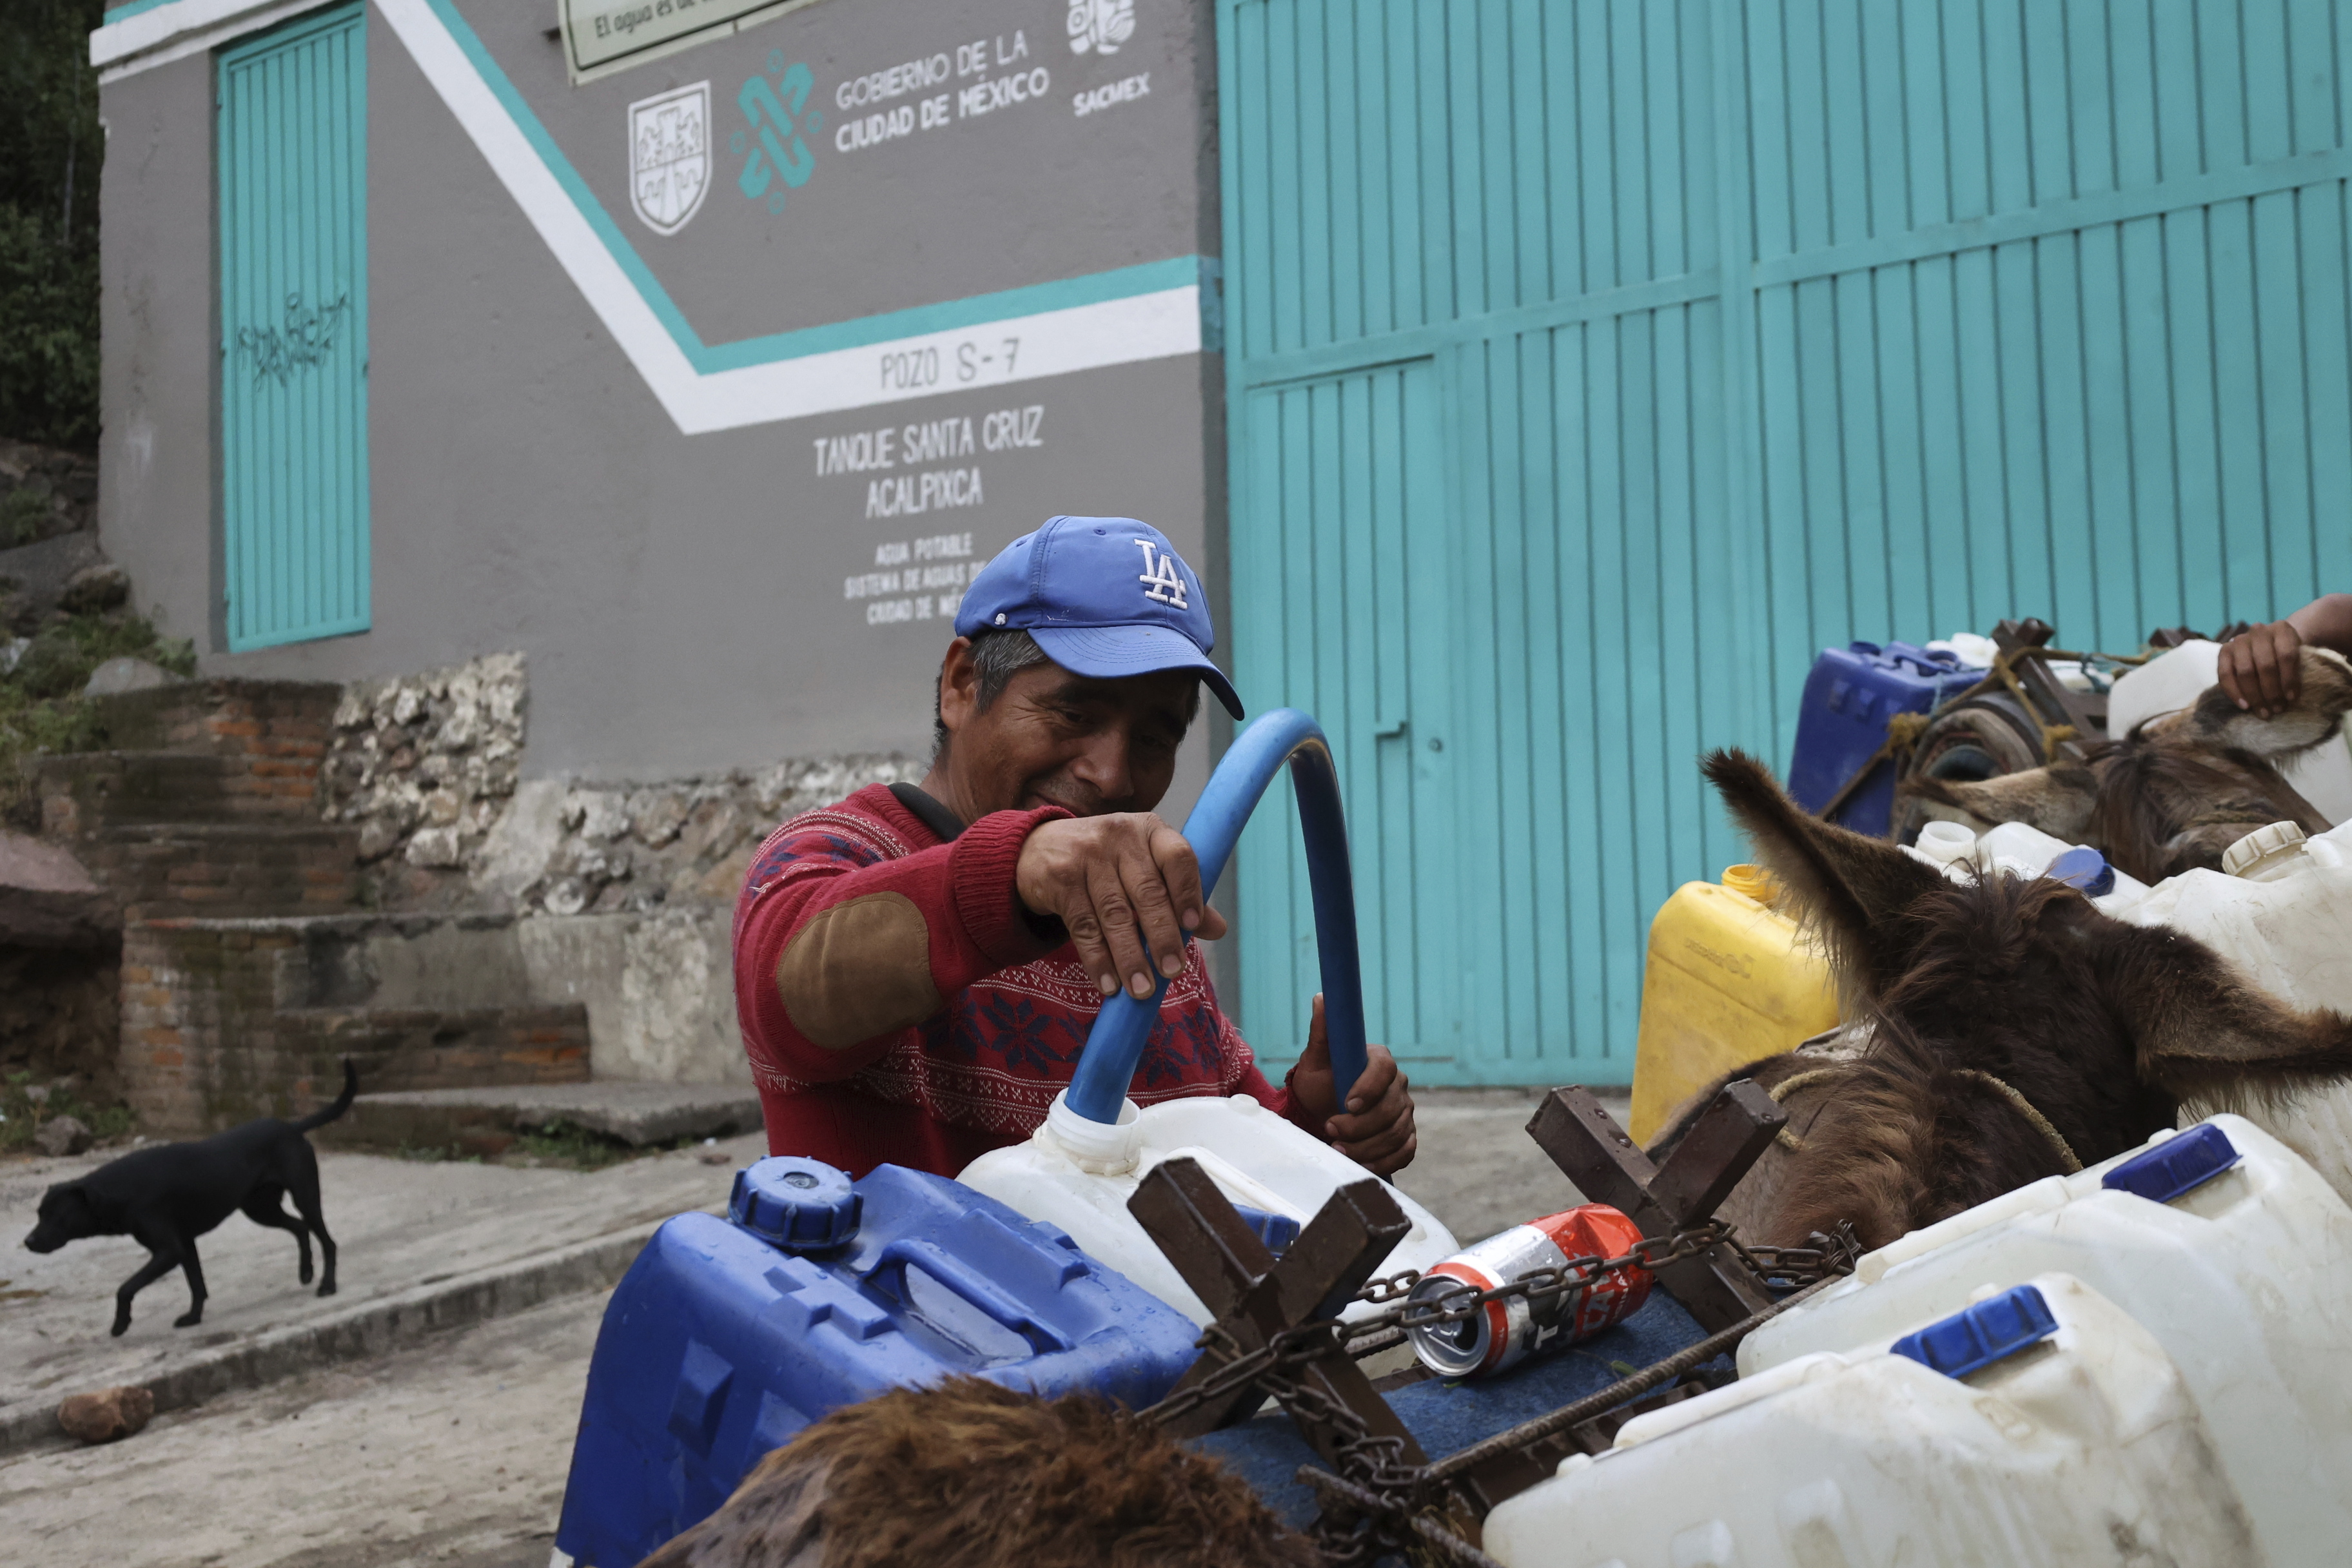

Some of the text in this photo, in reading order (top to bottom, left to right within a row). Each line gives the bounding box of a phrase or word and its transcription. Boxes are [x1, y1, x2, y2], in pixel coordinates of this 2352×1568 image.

[595, 14, 611, 37] El
[614, 5, 652, 33] agua
[656, 0, 672, 17] es
[836, 29, 1028, 110] GOBIERNO DE LA
[1073, 72, 1152, 117] SACMEX
[836, 67, 1050, 152] CIUDAD DE MÉXICO
[881, 337, 1020, 389] POZO S-7
[813, 404, 1045, 476] TANQUE SANTA CRUZ
[866, 466, 984, 518] ACALPIXCA
[875, 532, 973, 567] AGUA POTABLE
[1134, 538, 1188, 610] LA
[903, 568, 921, 592] DE
[922, 563, 966, 588] AGUAS
[867, 598, 914, 625] CIUDAD
[915, 595, 934, 620] DE
